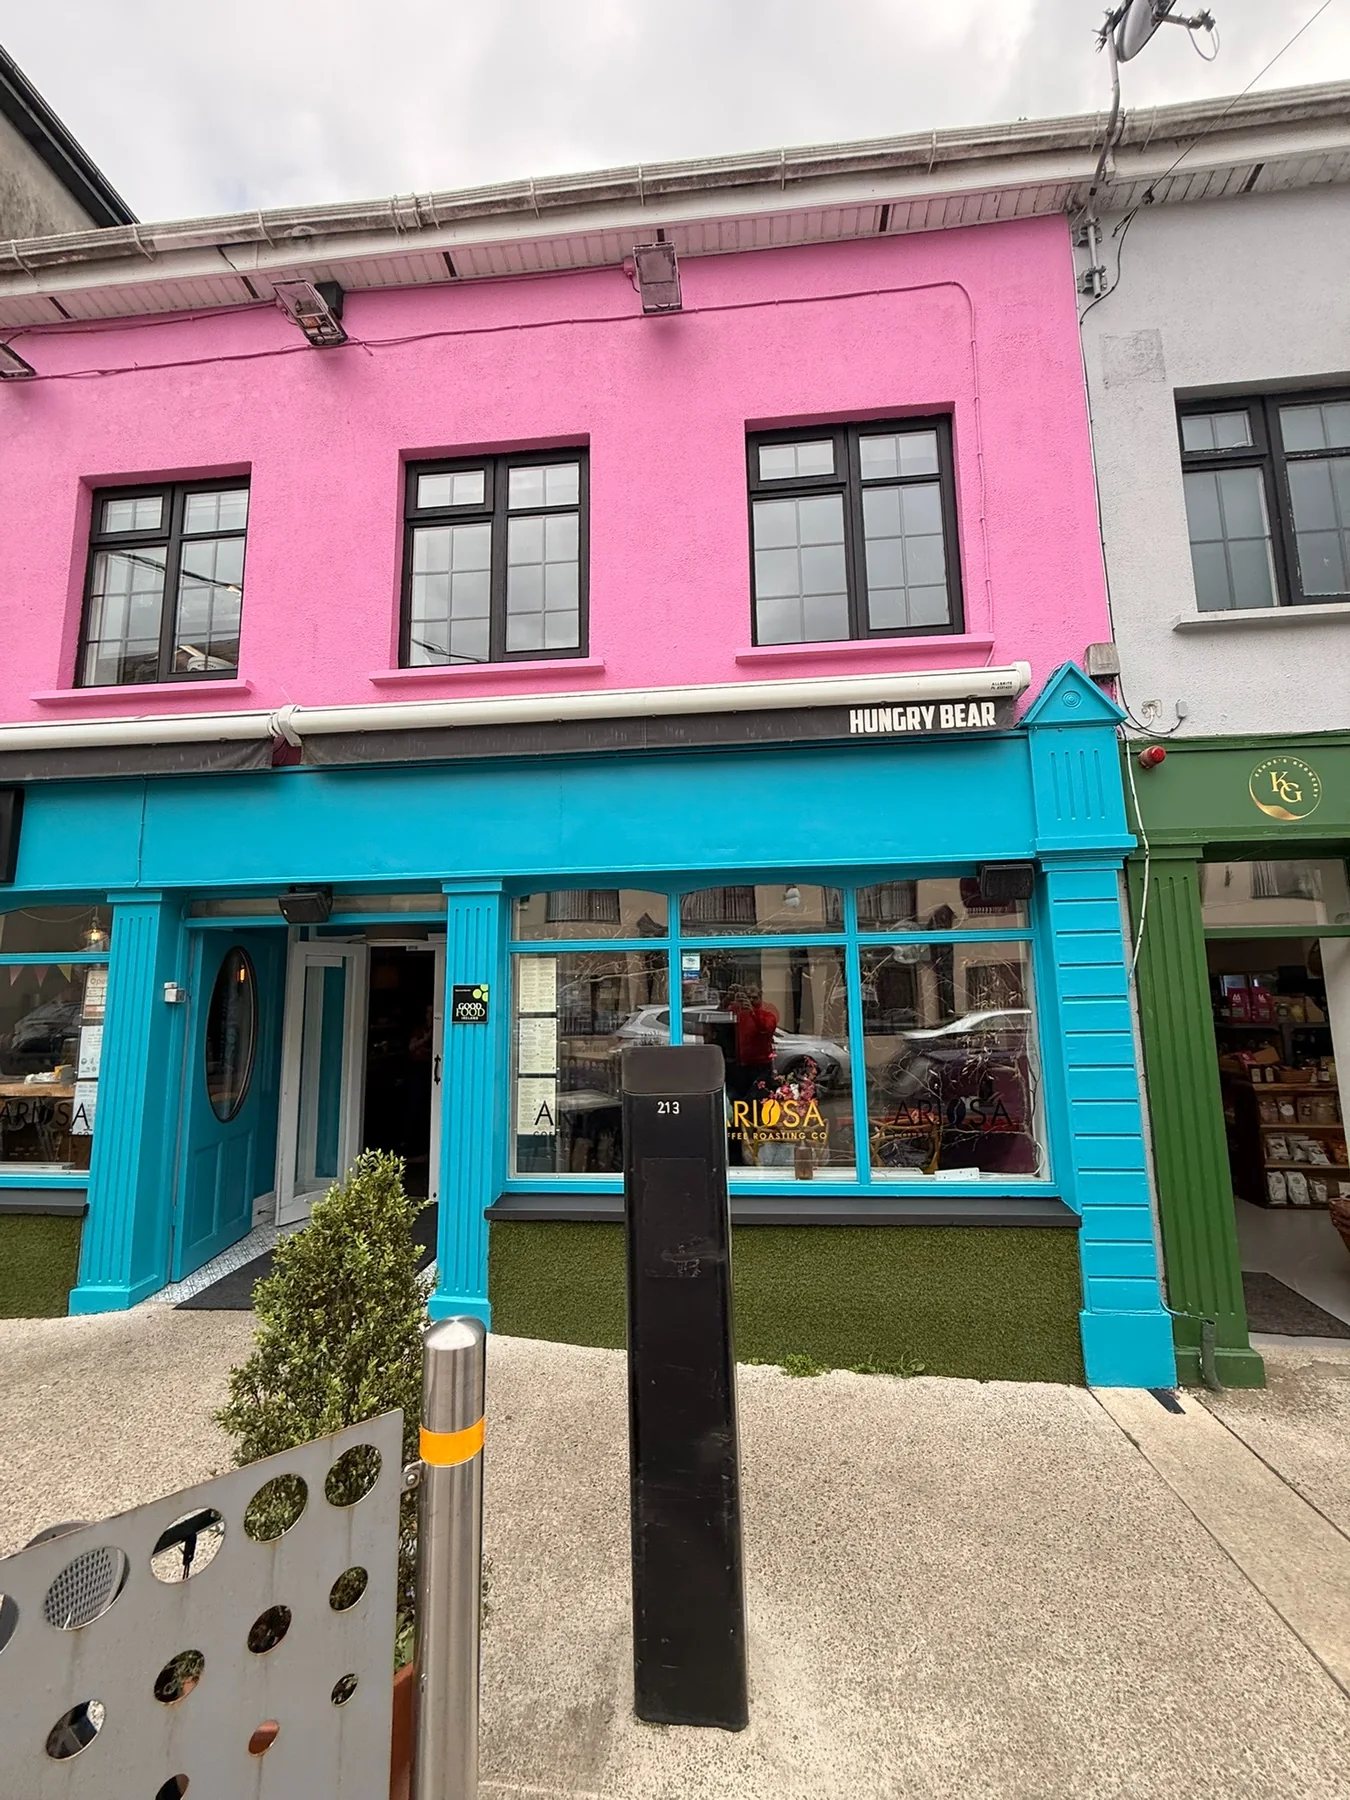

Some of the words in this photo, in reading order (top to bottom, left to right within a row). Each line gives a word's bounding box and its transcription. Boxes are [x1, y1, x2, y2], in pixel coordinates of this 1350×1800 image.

[849, 705, 935, 734] HUNGRY
[939, 701, 996, 729] BEAR
[456, 1008, 486, 1017] FOOD
[458, 1002, 483, 1010] GOOD
[657, 1101, 680, 1115] 213
[727, 1099, 825, 1128] RIOSA
[893, 1098, 1014, 1127] ARIOSA
[753, 1132, 806, 1140] ROASTING
[811, 1132, 828, 1140] CO
